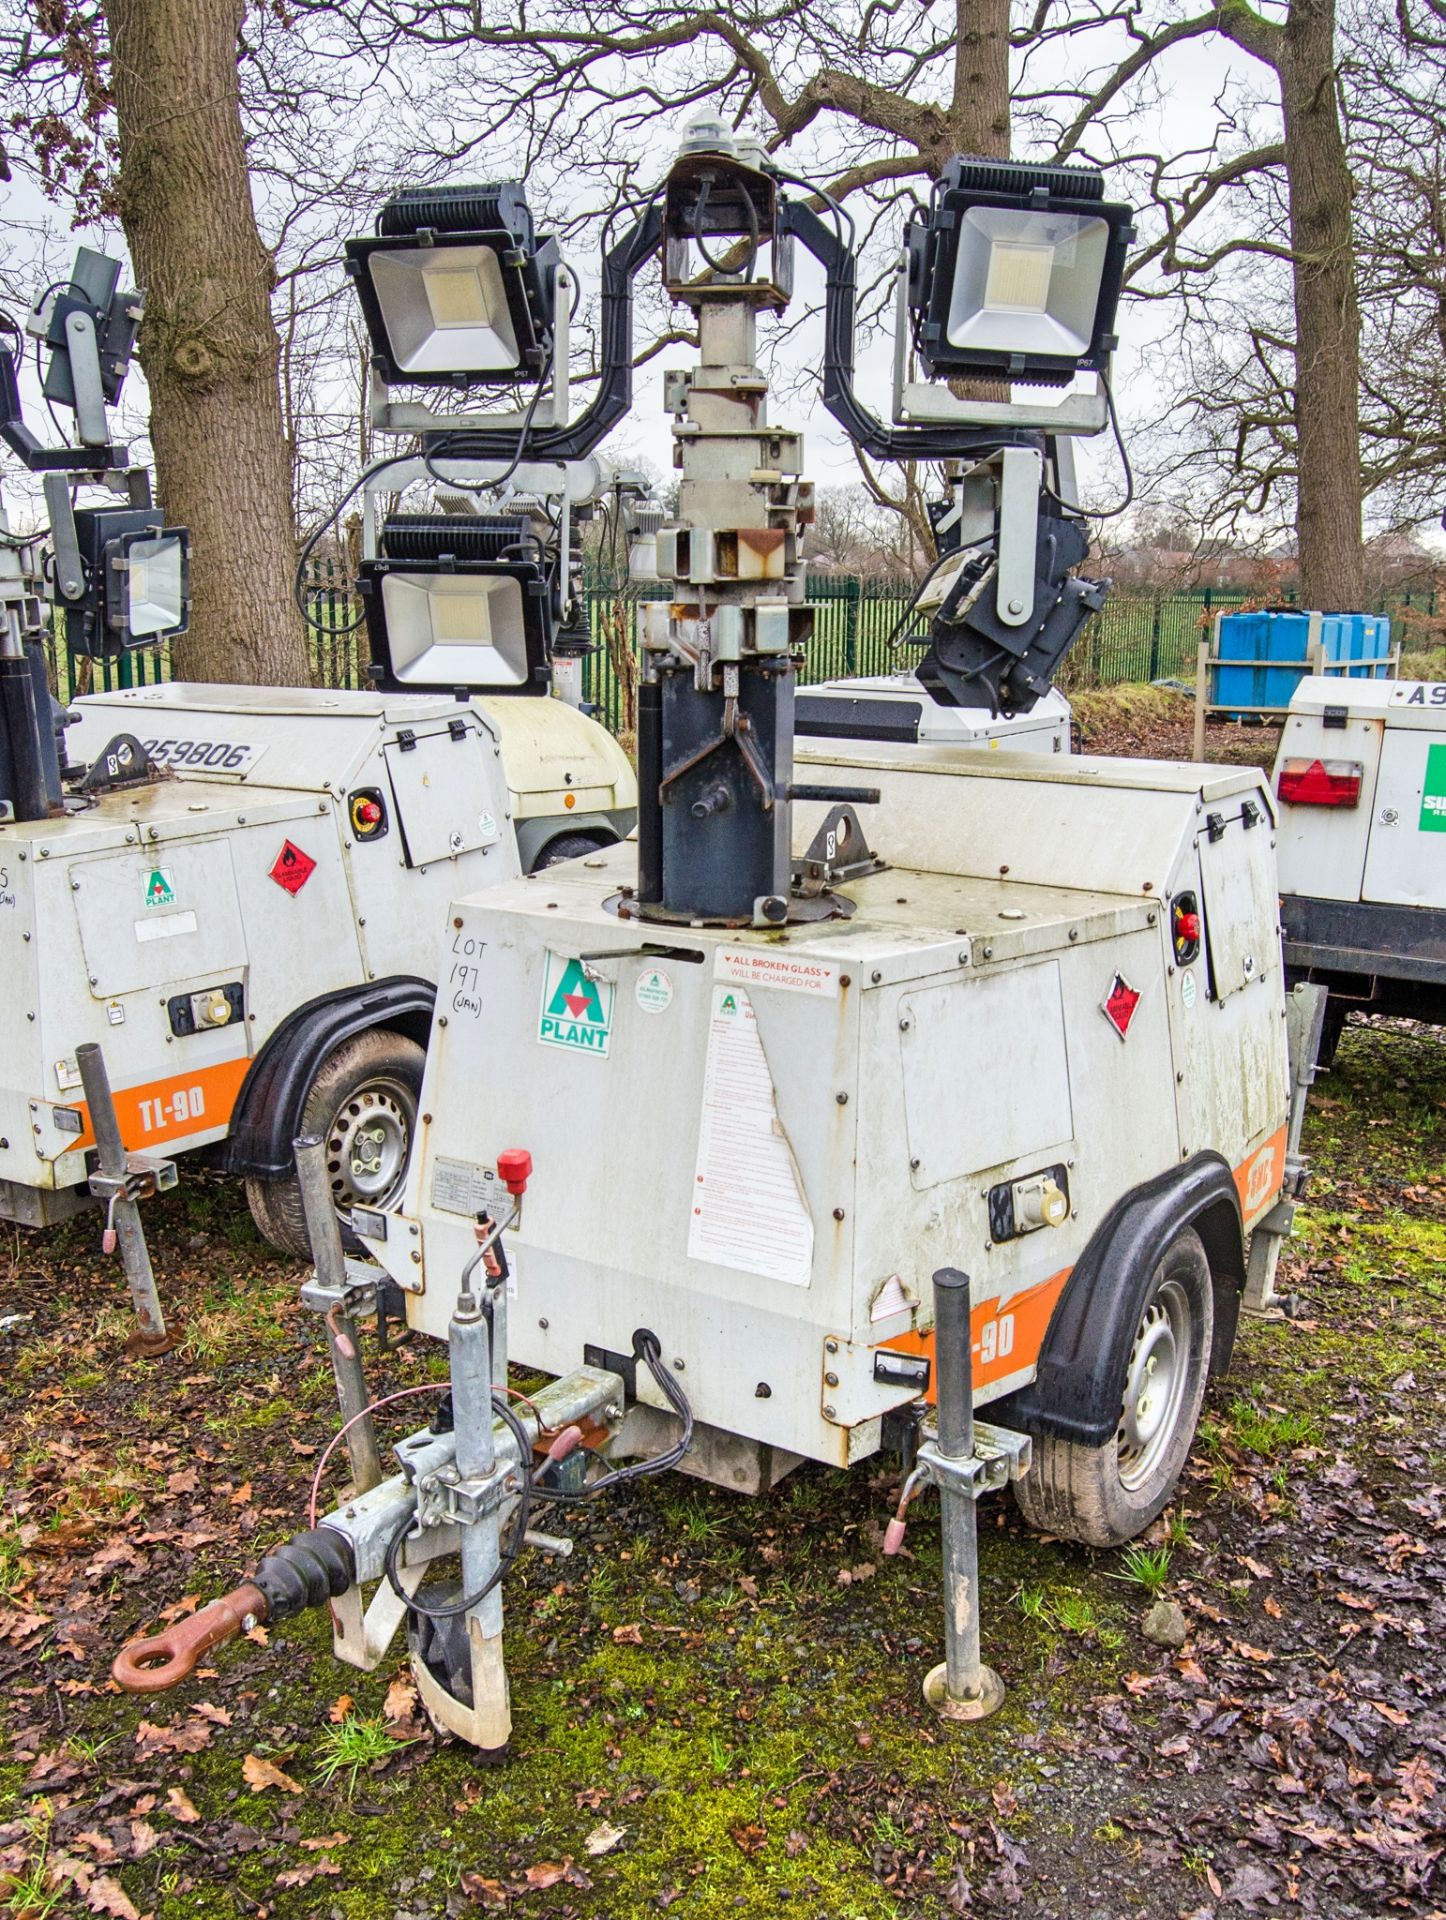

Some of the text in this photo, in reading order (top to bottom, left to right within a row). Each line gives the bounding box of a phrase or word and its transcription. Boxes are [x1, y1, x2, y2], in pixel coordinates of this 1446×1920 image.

[145, 894, 175, 906] PLANT
[452, 934, 488, 959] LOT
[449, 963, 479, 992] 197
[730, 968, 822, 989] WILL BE CHARGED FOR
[733, 956, 821, 976] ALL BROKEN GLASS
[547, 958, 605, 1024] A
[540, 1018, 609, 1048] PLANT
[138, 1086, 205, 1132] TL-90
